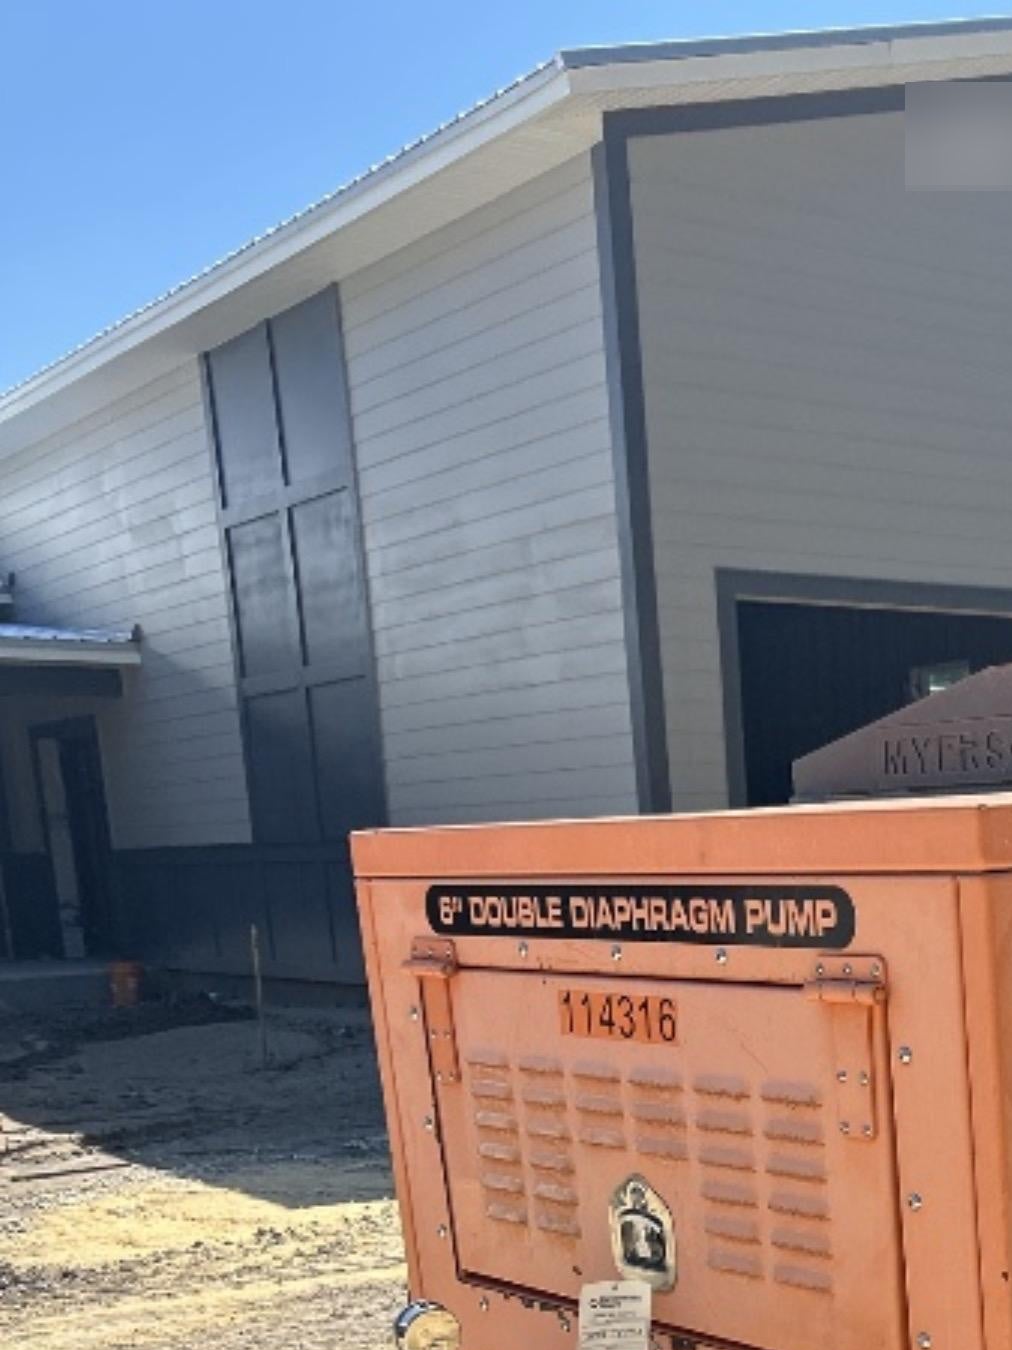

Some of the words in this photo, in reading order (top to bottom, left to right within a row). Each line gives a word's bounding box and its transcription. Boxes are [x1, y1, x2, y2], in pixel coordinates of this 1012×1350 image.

[469, 895, 565, 929] DOUBLE
[570, 897, 736, 935] DIAPHRAGM
[745, 899, 839, 938] PUMP
[560, 991, 677, 1042] 114316
